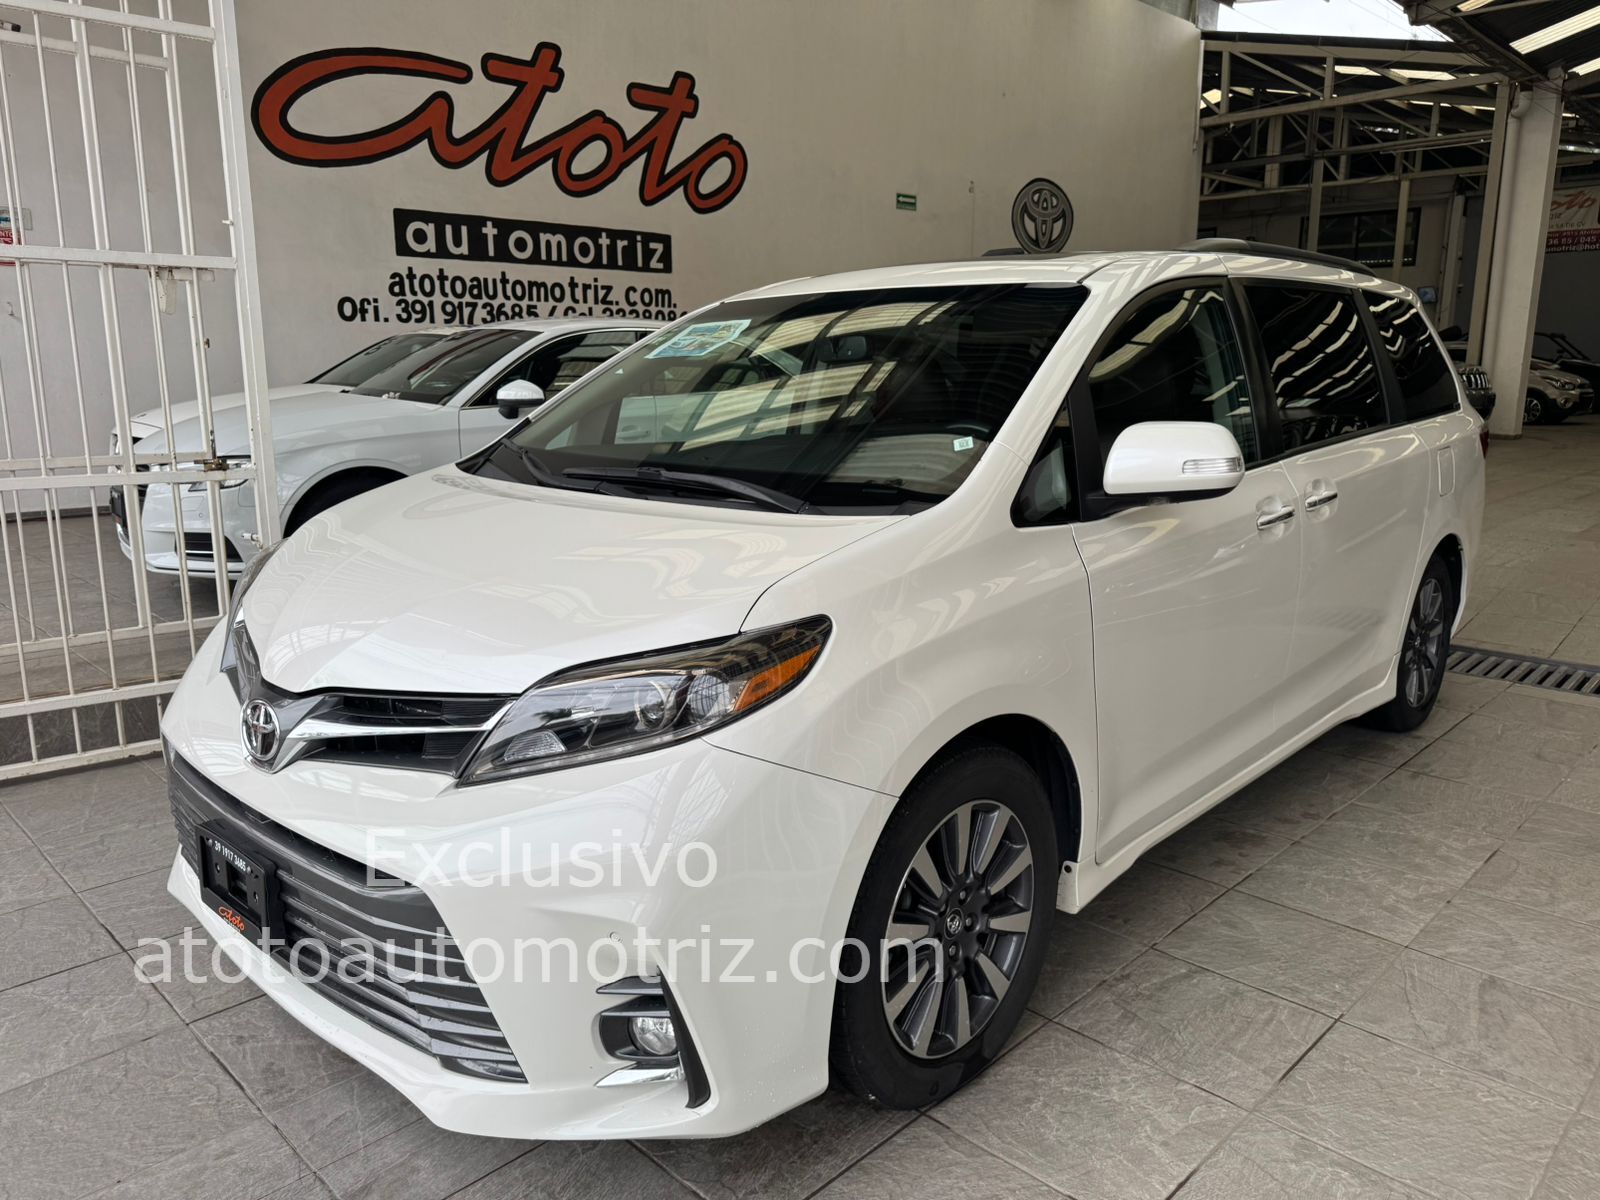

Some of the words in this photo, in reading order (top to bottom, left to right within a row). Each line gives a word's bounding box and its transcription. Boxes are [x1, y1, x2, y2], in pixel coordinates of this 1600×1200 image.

[405, 221, 664, 269] automotriz
[337, 296, 389, 322] Ofi.
[395, 298, 435, 324] 391
[214, 840, 221, 852] 39
